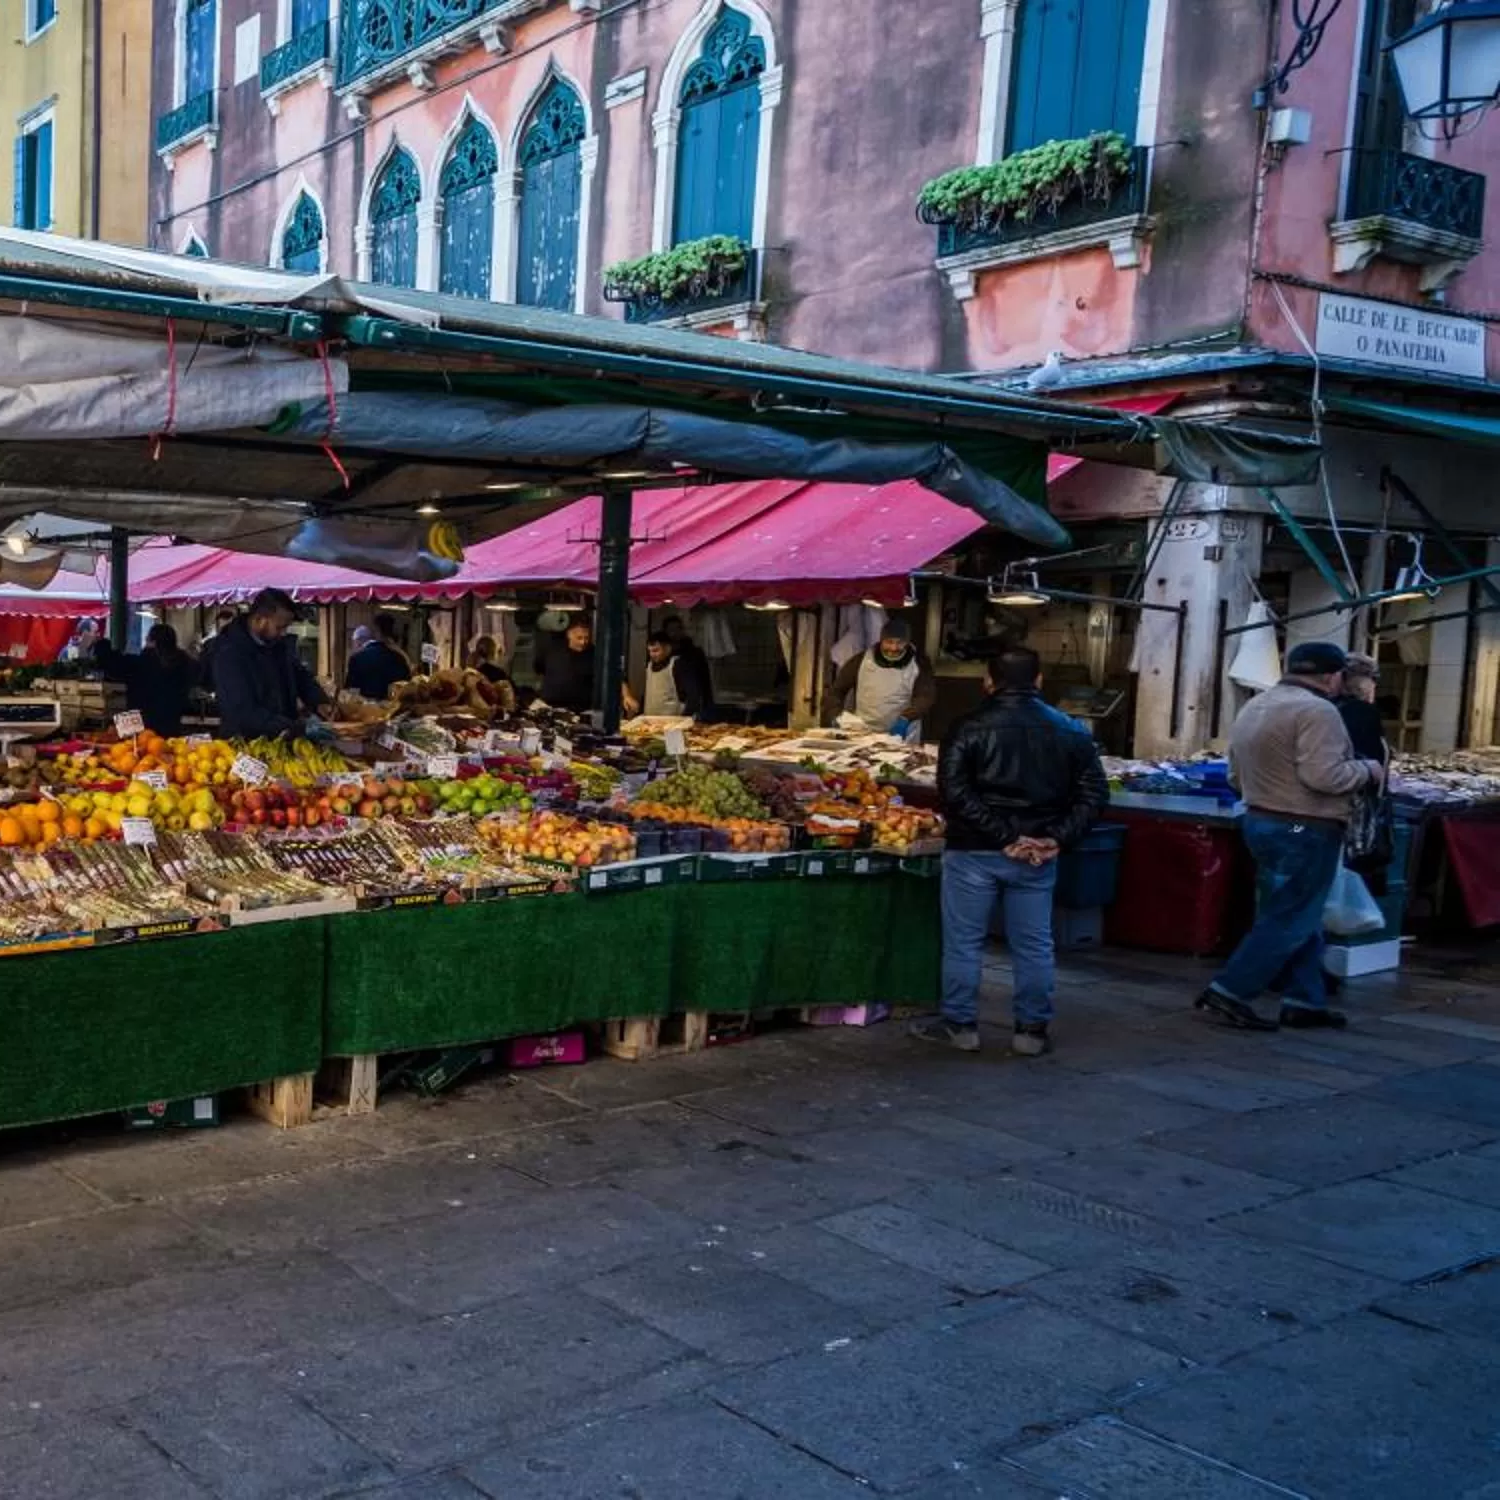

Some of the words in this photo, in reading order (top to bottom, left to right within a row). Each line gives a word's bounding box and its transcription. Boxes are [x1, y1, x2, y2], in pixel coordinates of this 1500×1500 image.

[1323, 304, 1367, 325] CALLE
[1371, 310, 1390, 329] DE
[1394, 314, 1409, 333] LE
[1417, 320, 1480, 345] BECCARIE
[1357, 336, 1369, 353] O
[1376, 338, 1447, 363] PANATERIA
